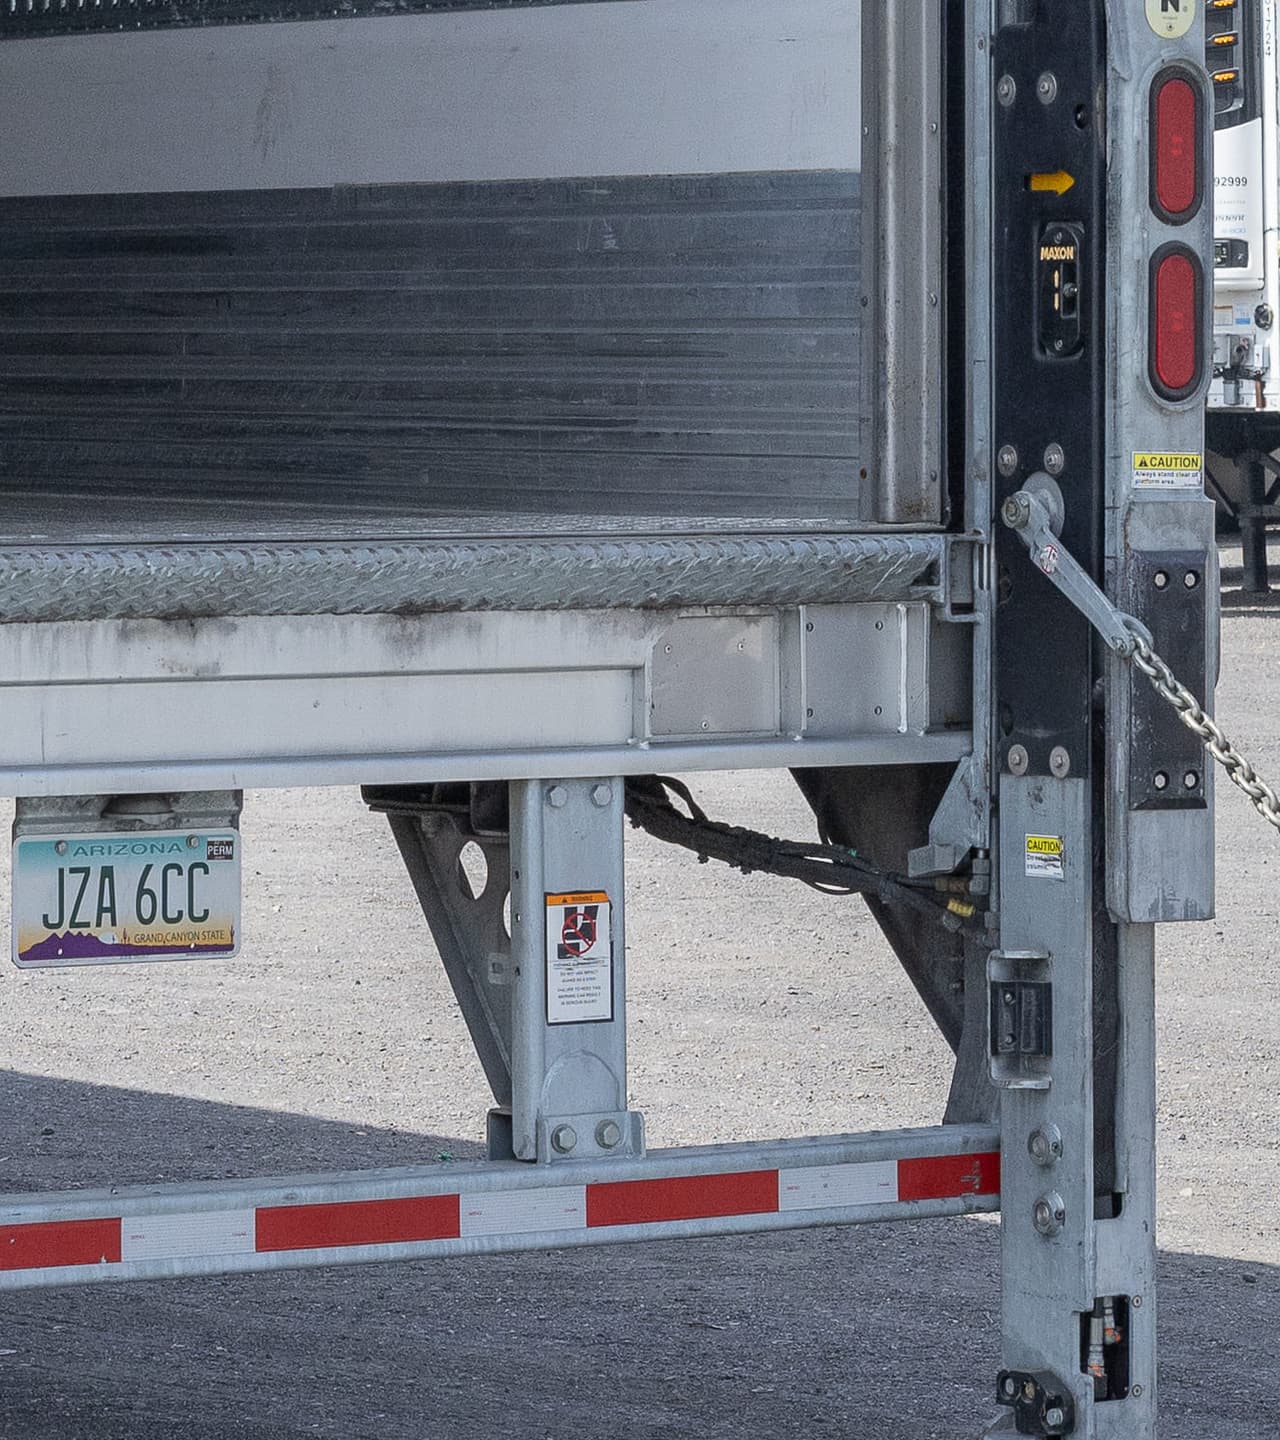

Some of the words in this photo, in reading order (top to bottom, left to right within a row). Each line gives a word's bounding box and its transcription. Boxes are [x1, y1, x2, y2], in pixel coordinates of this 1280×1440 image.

[1040, 245, 1074, 261] MAXON
[1149, 456, 1199, 468] CAUTION
[73, 842, 182, 857] ARIZONA
[207, 844, 233, 856] PERM
[1026, 839, 1061, 852] CAUTION
[42, 865, 118, 930] JZA
[135, 861, 210, 925] 6CC
[133, 933, 164, 945] GRAND
[165, 931, 200, 942] CANYON
[201, 929, 225, 941] STATE
